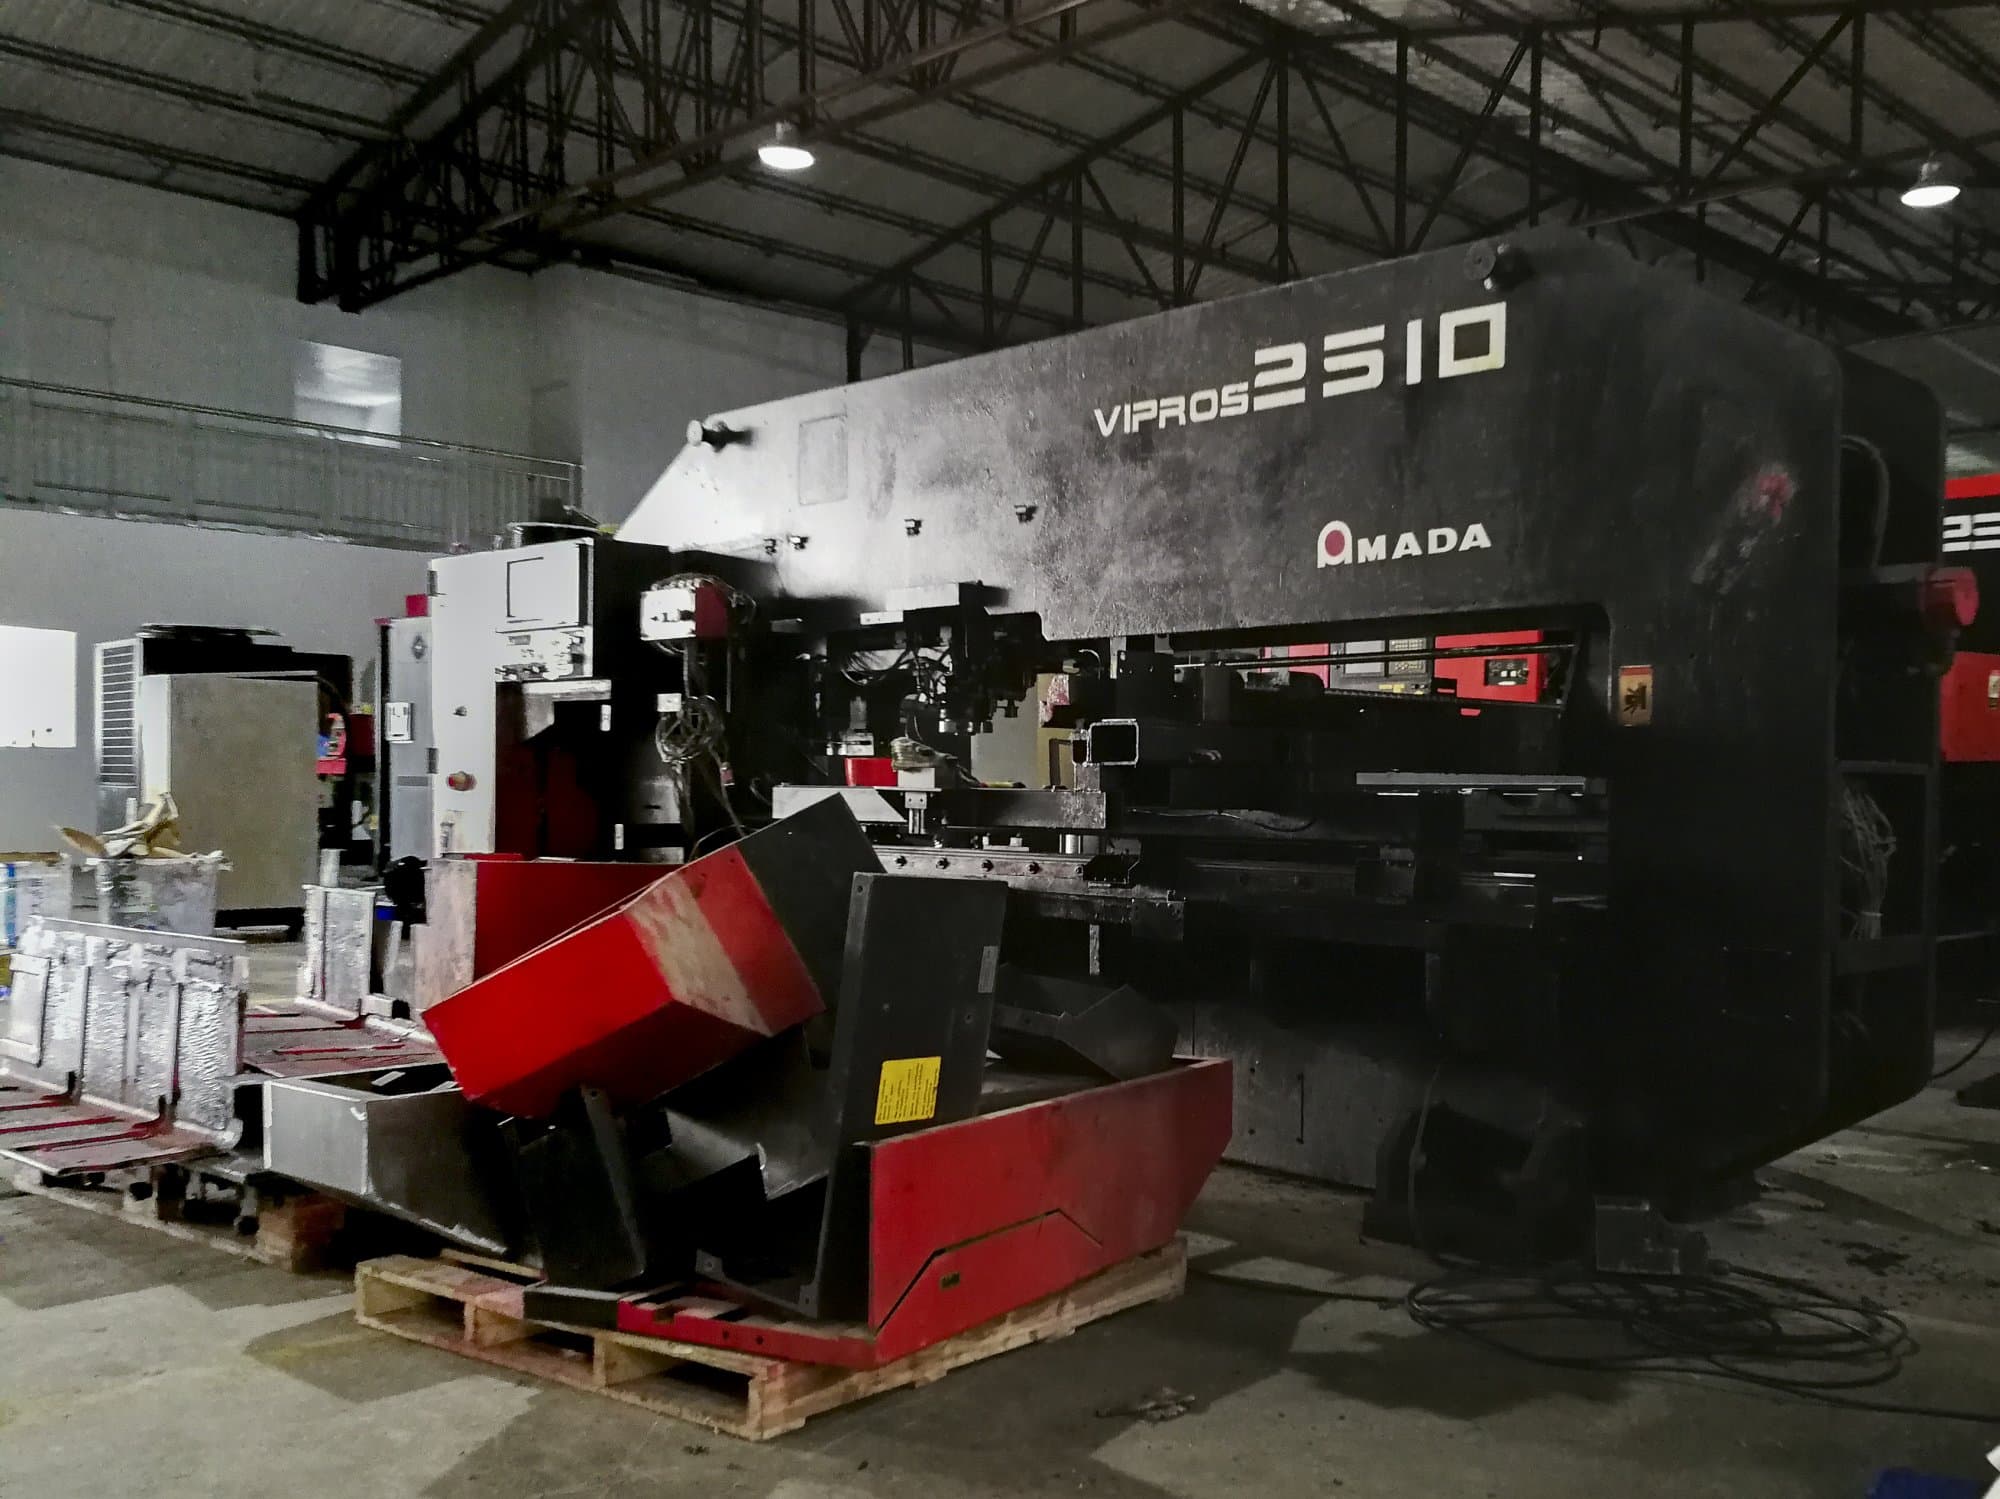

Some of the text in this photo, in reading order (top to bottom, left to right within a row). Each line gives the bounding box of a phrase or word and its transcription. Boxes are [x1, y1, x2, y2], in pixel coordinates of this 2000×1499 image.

[1093, 301, 1507, 437] VIPROS 2510
[1316, 520, 1492, 569] AMADA
